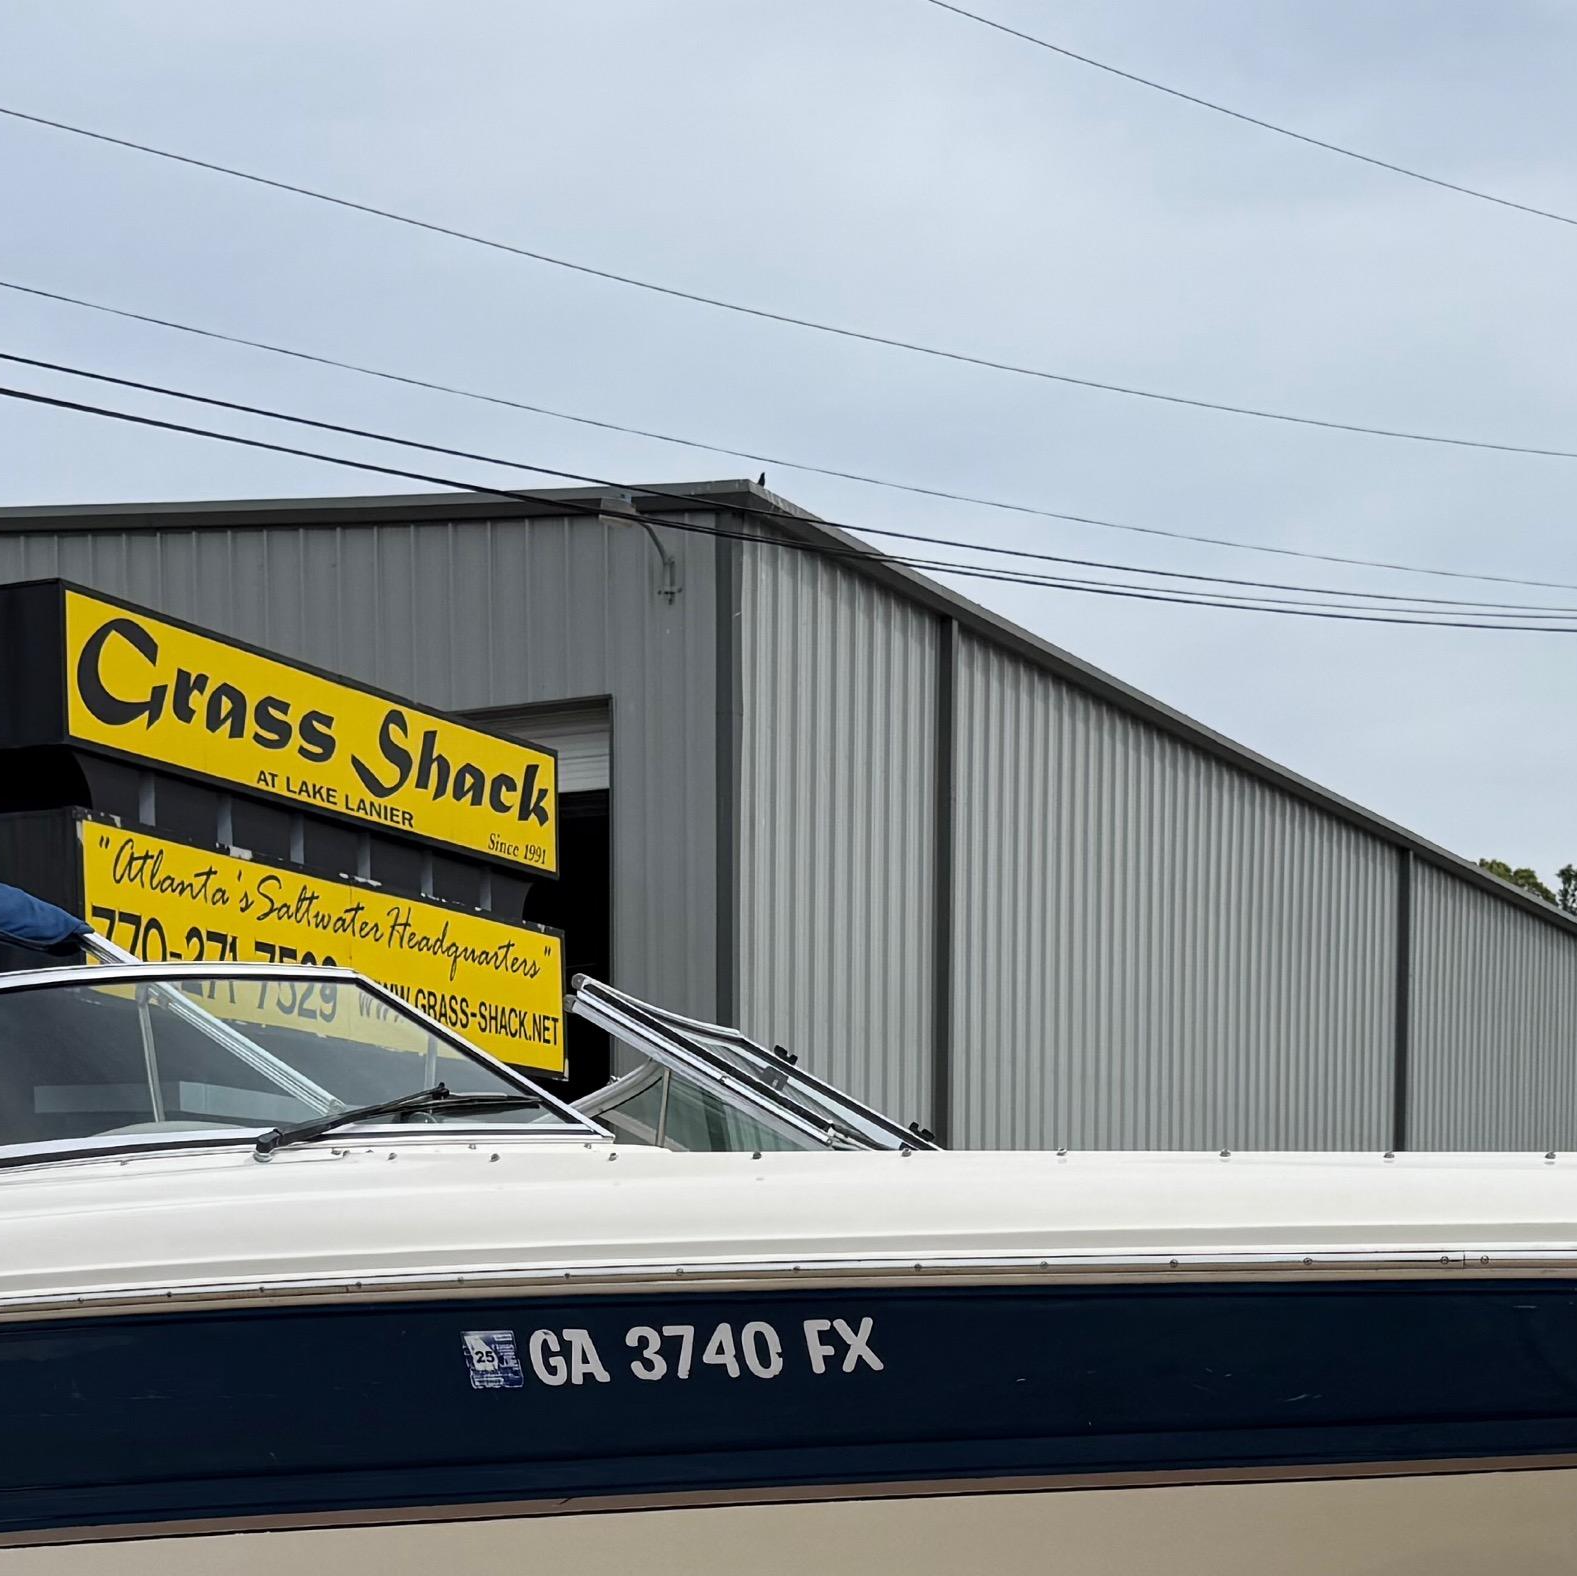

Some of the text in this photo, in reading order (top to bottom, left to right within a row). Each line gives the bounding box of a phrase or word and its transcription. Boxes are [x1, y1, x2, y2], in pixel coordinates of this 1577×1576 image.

[76, 617, 550, 828] Grass Shack
[256, 769, 415, 829] AT LAKE LANIER
[487, 832, 547, 866] Since 1991
[255, 873, 385, 943] Saltwater
[359, 979, 559, 1046] WWWGRASS-SHACK.NET
[474, 1350, 496, 1364] 25
[529, 1329, 610, 1386] GA
[625, 1321, 783, 1381] 3740
[804, 1317, 884, 1374] FX
